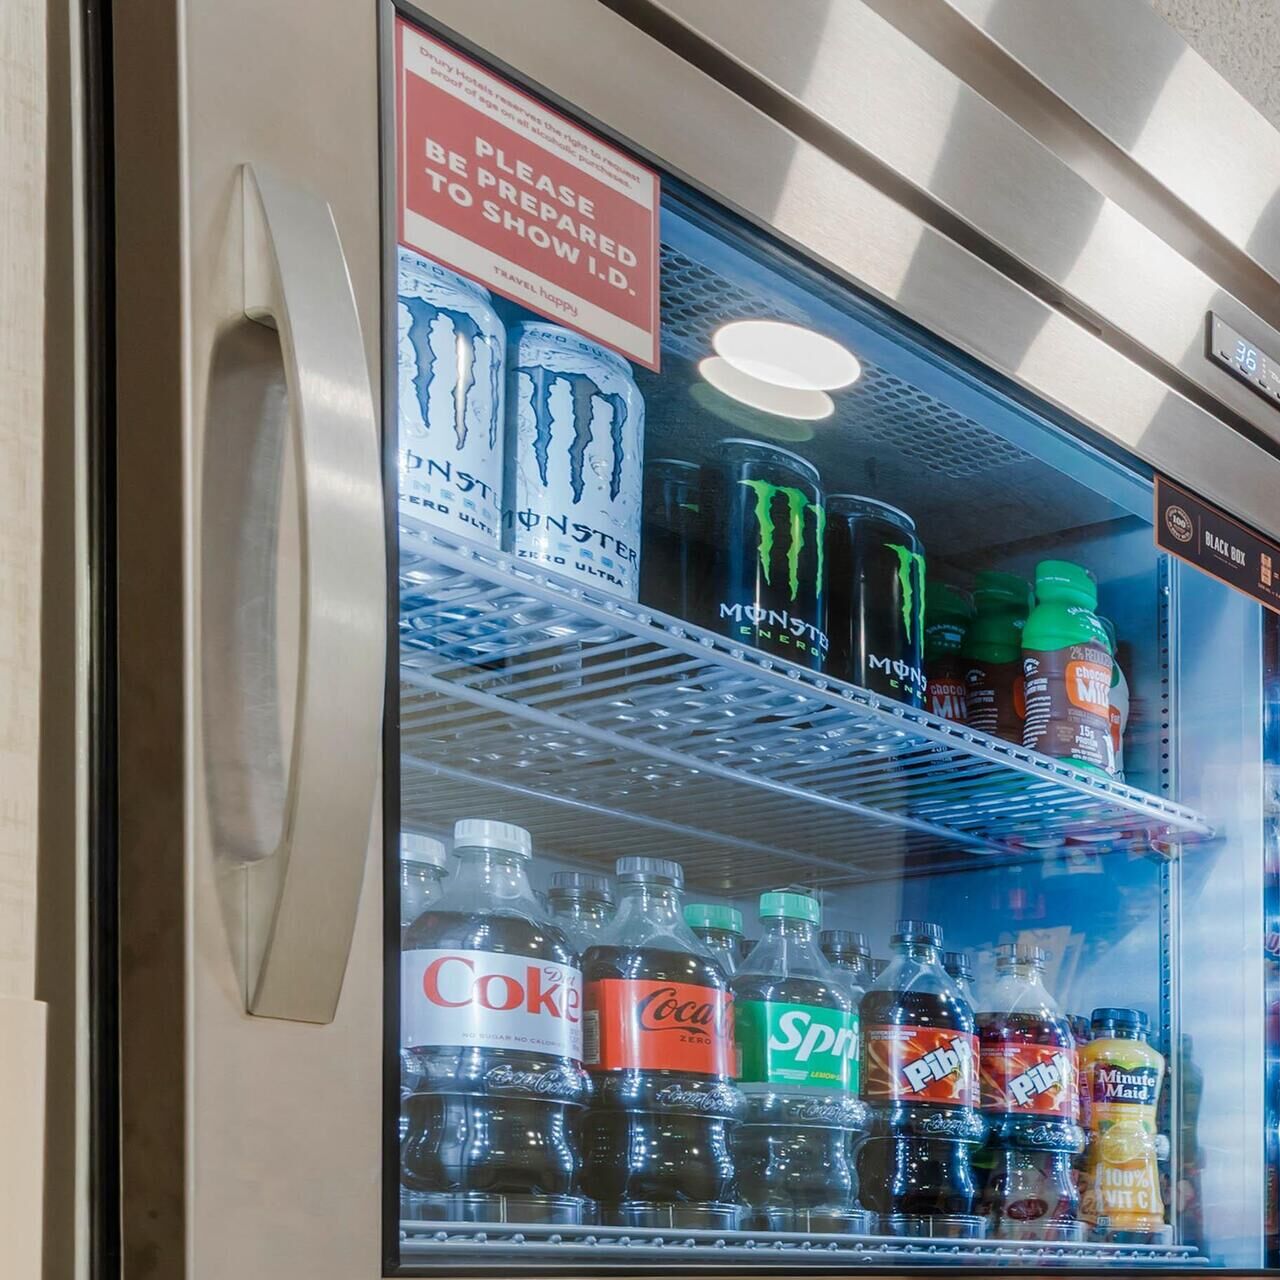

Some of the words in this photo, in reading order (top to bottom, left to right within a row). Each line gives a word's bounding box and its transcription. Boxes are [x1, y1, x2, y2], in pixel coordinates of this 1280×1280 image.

[475, 136, 595, 220] PLEASE
[425, 137, 469, 178] BE
[476, 166, 638, 268] PREPARED
[424, 168, 474, 208] TO
[481, 200, 581, 265] SHOW
[587, 255, 637, 297] I.D.
[493, 265, 537, 294] TRAVEL
[538, 285, 579, 318] happy
[1235, 340, 1257, 372] 36
[1205, 530, 1229, 559] BLACK
[1230, 545, 1246, 567] BOX
[574, 561, 625, 589] ULTRA
[739, 625, 827, 662] ENERGY
[422, 955, 580, 1023] Coke
[679, 1034, 712, 1045] ZERO
[768, 1009, 860, 1062] Spri
[902, 1035, 974, 1093] Pibb
[1007, 1048, 1074, 1105] Pibb
[1098, 1067, 1156, 1089] Minute
[1105, 1080, 1149, 1101] Maid
[1104, 1167, 1150, 1189] 100%
[1106, 1190, 1135, 1208] VIT
[1137, 1190, 1149, 1208] C
